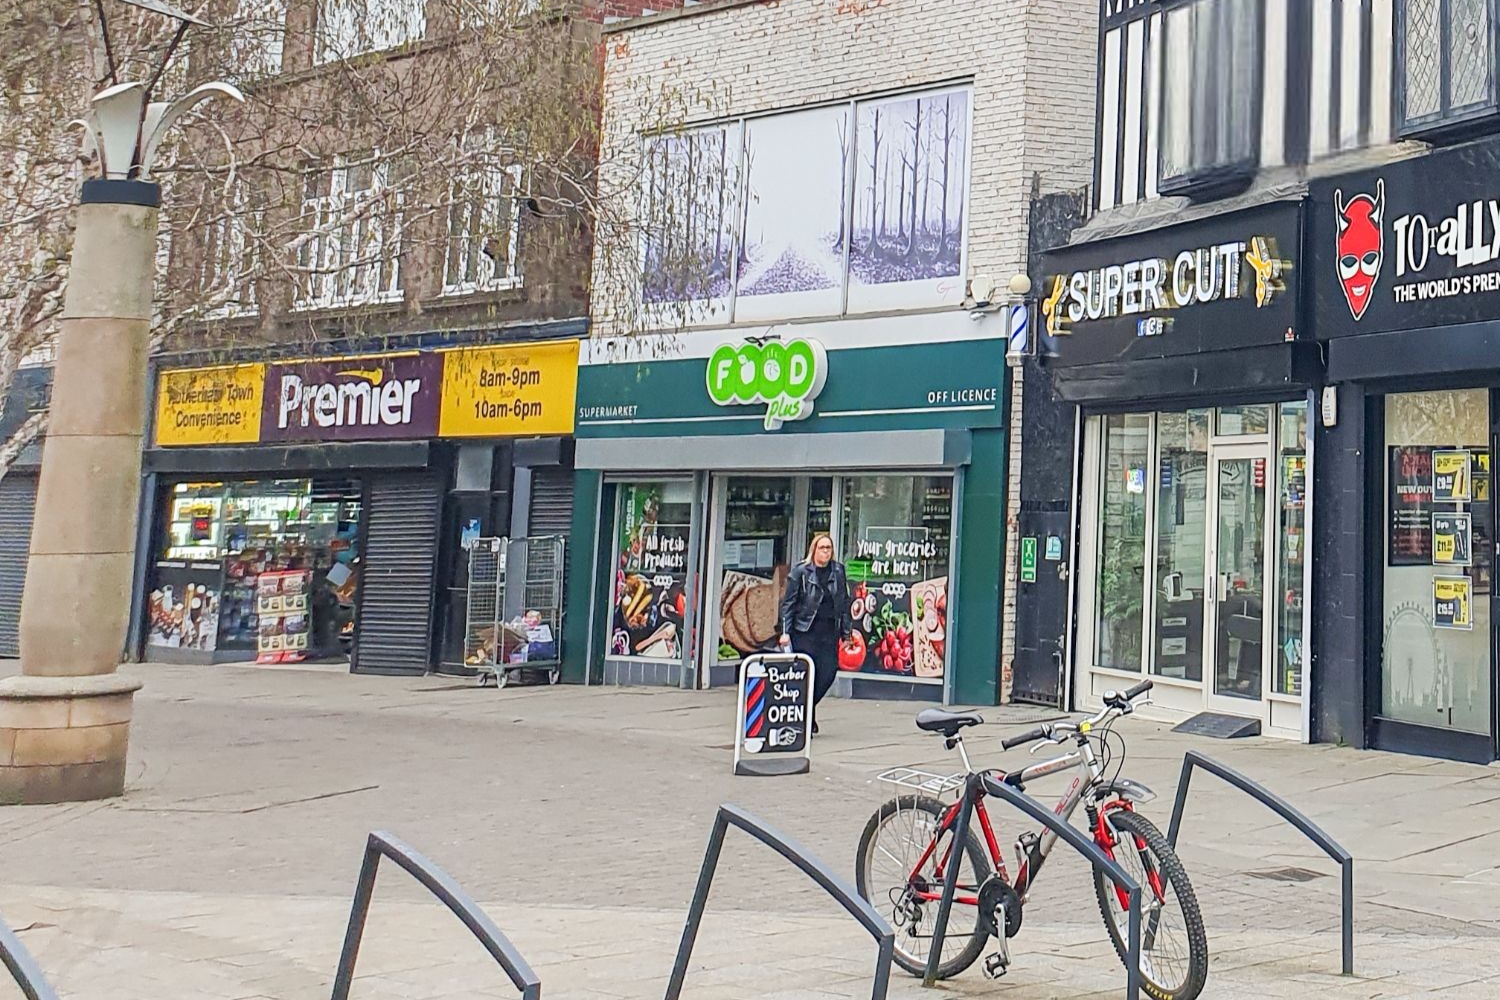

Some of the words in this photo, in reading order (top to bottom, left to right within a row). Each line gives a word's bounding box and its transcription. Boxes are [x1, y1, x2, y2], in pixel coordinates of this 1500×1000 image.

[1068, 257, 1163, 322] SUPER
[1173, 241, 1245, 307] CUT
[1393, 284, 1416, 303] THE
[1417, 277, 1471, 298] WORLD'S
[716, 352, 808, 390] FOOD
[278, 368, 421, 428] Premier
[928, 391, 947, 404] OFF
[951, 388, 997, 402] LICENCE
[175, 410, 241, 428] Convenience
[474, 399, 542, 420] 10am-6pm
[579, 404, 638, 418] SUPERMARKET
[768, 397, 801, 427] plus
[646, 535, 658, 550] All
[661, 535, 685, 552] fresh
[886, 539, 937, 558] groceries
[644, 552, 684, 569] Products
[872, 560, 890, 575] are
[893, 559, 919, 576] here!
[768, 667, 807, 683] Barber
[773, 683, 800, 703] Shop
[767, 704, 804, 723] OPEN
